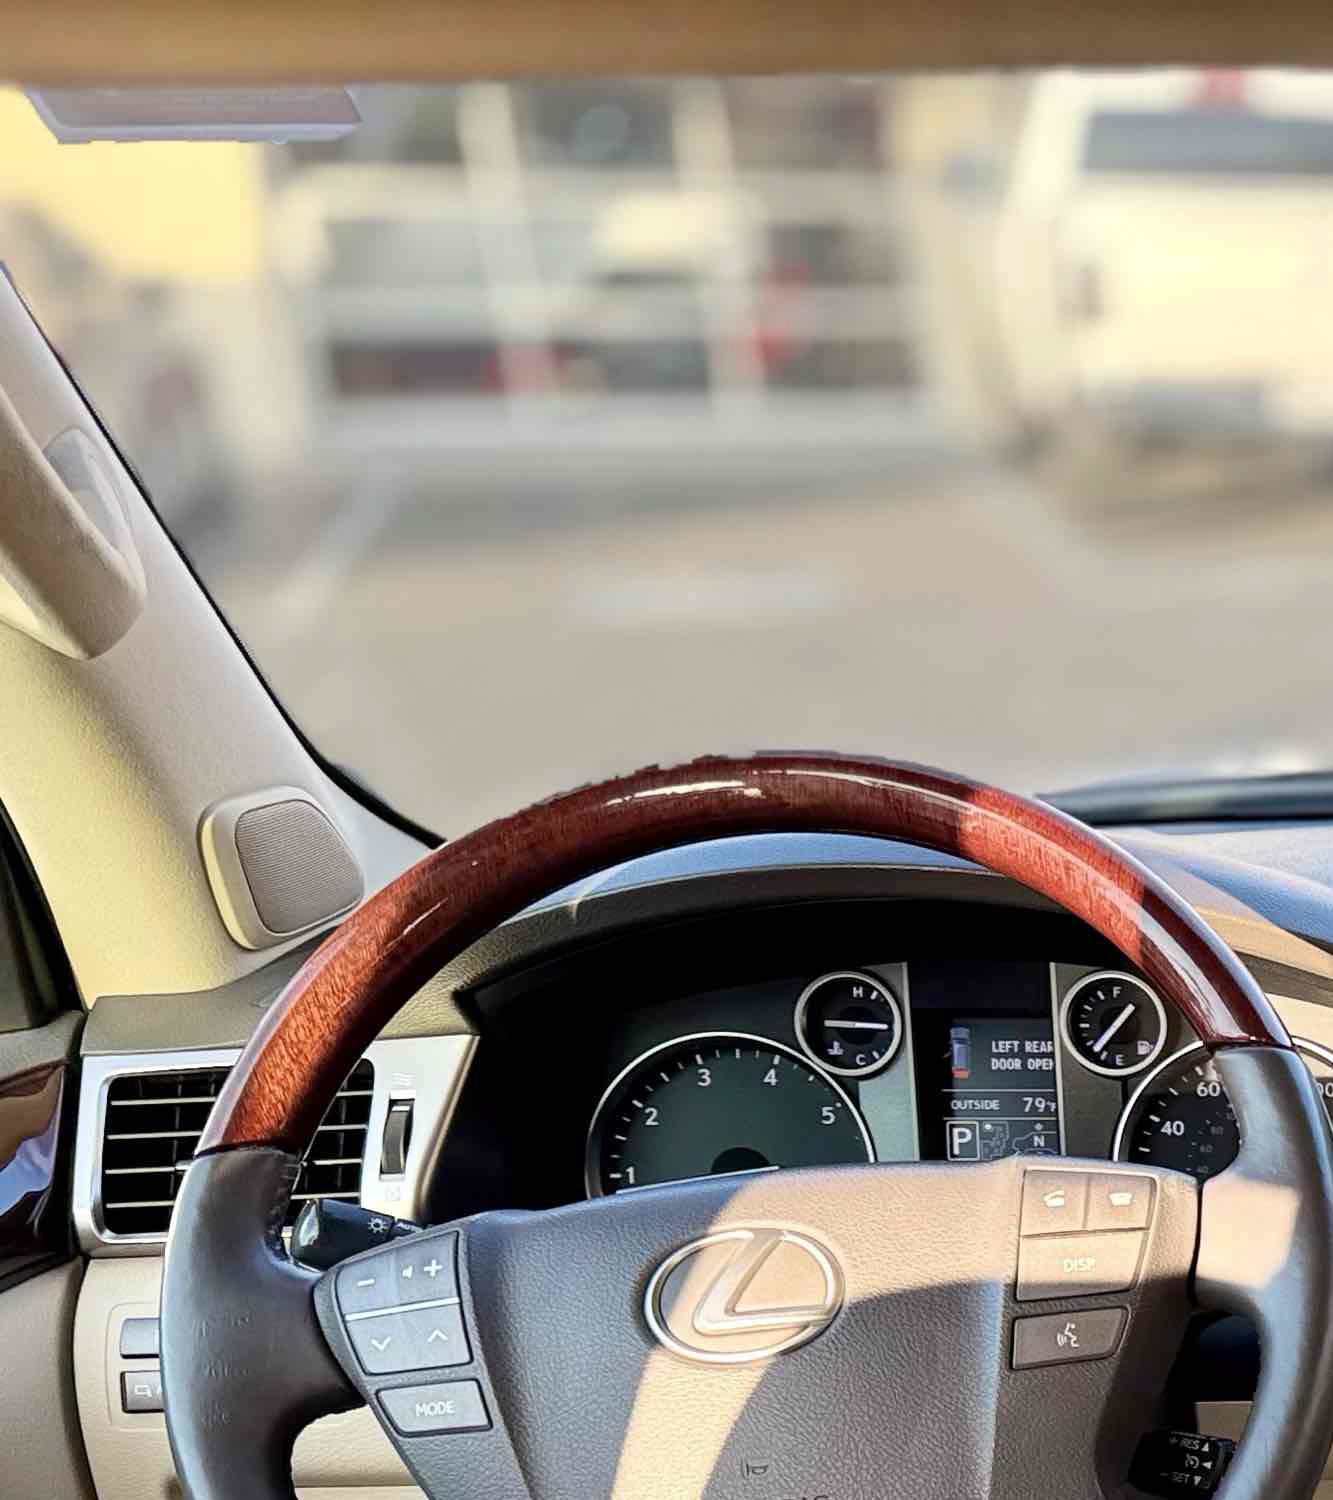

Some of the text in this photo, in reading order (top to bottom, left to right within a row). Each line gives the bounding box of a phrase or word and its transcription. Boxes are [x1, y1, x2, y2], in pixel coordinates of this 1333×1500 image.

[852, 986, 863, 998] H
[1112, 986, 1122, 998] F
[991, 1040, 1020, 1053] LEFT
[855, 1054, 866, 1066] C
[991, 1057, 1022, 1071] DOOR
[1115, 1054, 1125, 1066] E
[696, 1068, 712, 1087] 3
[762, 1069, 778, 1086] 4
[1196, 1081, 1221, 1097] 60
[950, 1099, 1001, 1111] OUTSIDE
[644, 1107, 660, 1126] 2
[820, 1106, 836, 1125] 5
[1160, 1120, 1185, 1137] 40
[951, 1127, 972, 1156] P
[1033, 1135, 1045, 1147] N
[624, 1165, 636, 1185] 1
[1063, 1257, 1097, 1273] DISP
[415, 1400, 457, 1417] MODE
